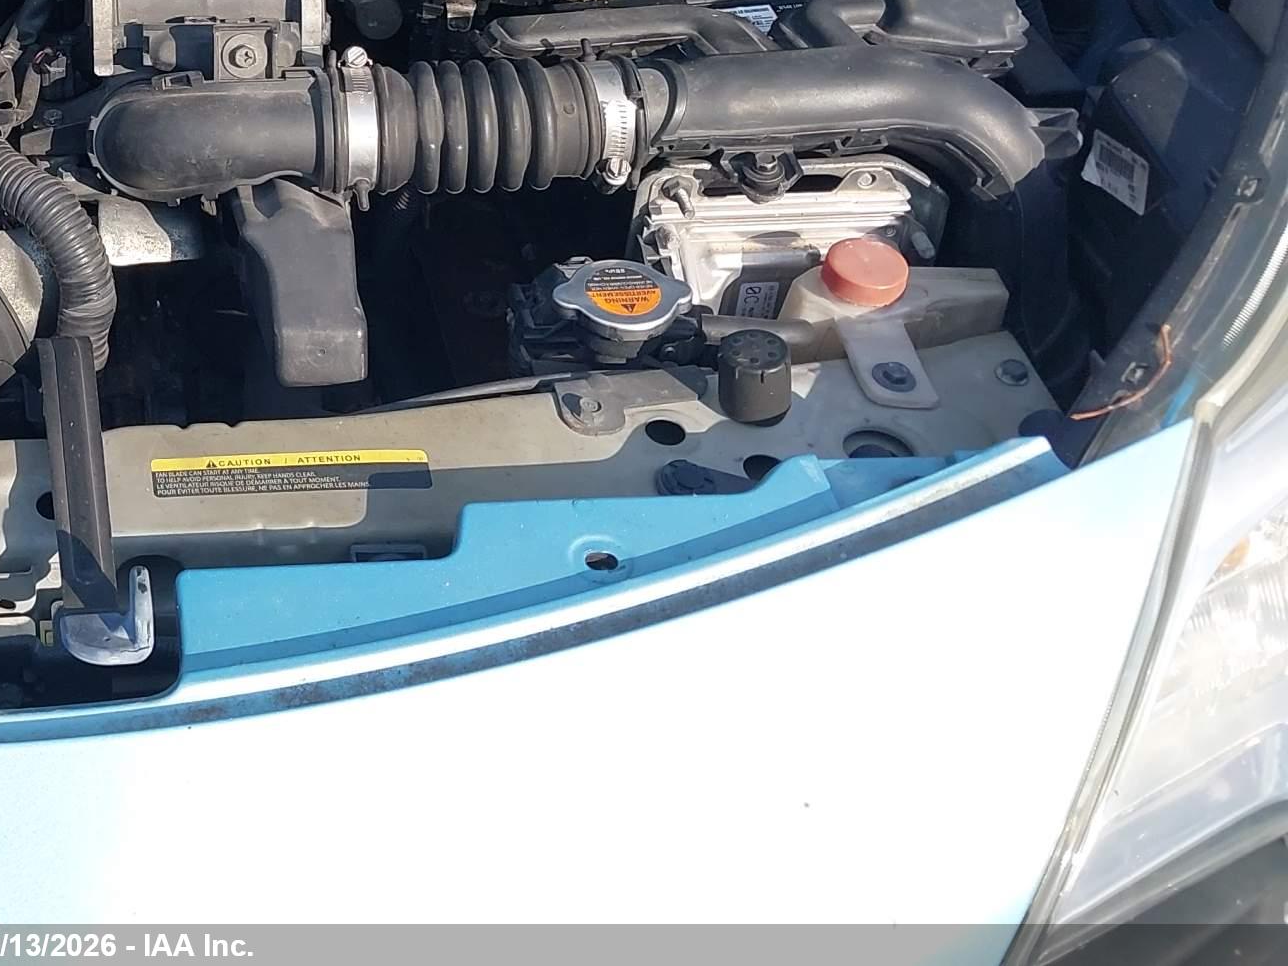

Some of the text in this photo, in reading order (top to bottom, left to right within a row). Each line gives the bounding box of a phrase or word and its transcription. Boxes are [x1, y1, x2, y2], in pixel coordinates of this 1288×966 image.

[592, 290, 656, 298] AVERTISSEMENT
[604, 296, 650, 304] WARNING
[218, 458, 271, 467] CAUTION
[297, 454, 361, 464] ATTENTION
[202, 474, 233, 482] PERSONAL
[165, 481, 209, 489] VENTILATEUR
[200, 486, 223, 494] TOUTE
[293, 482, 334, 490] APPROCHER
